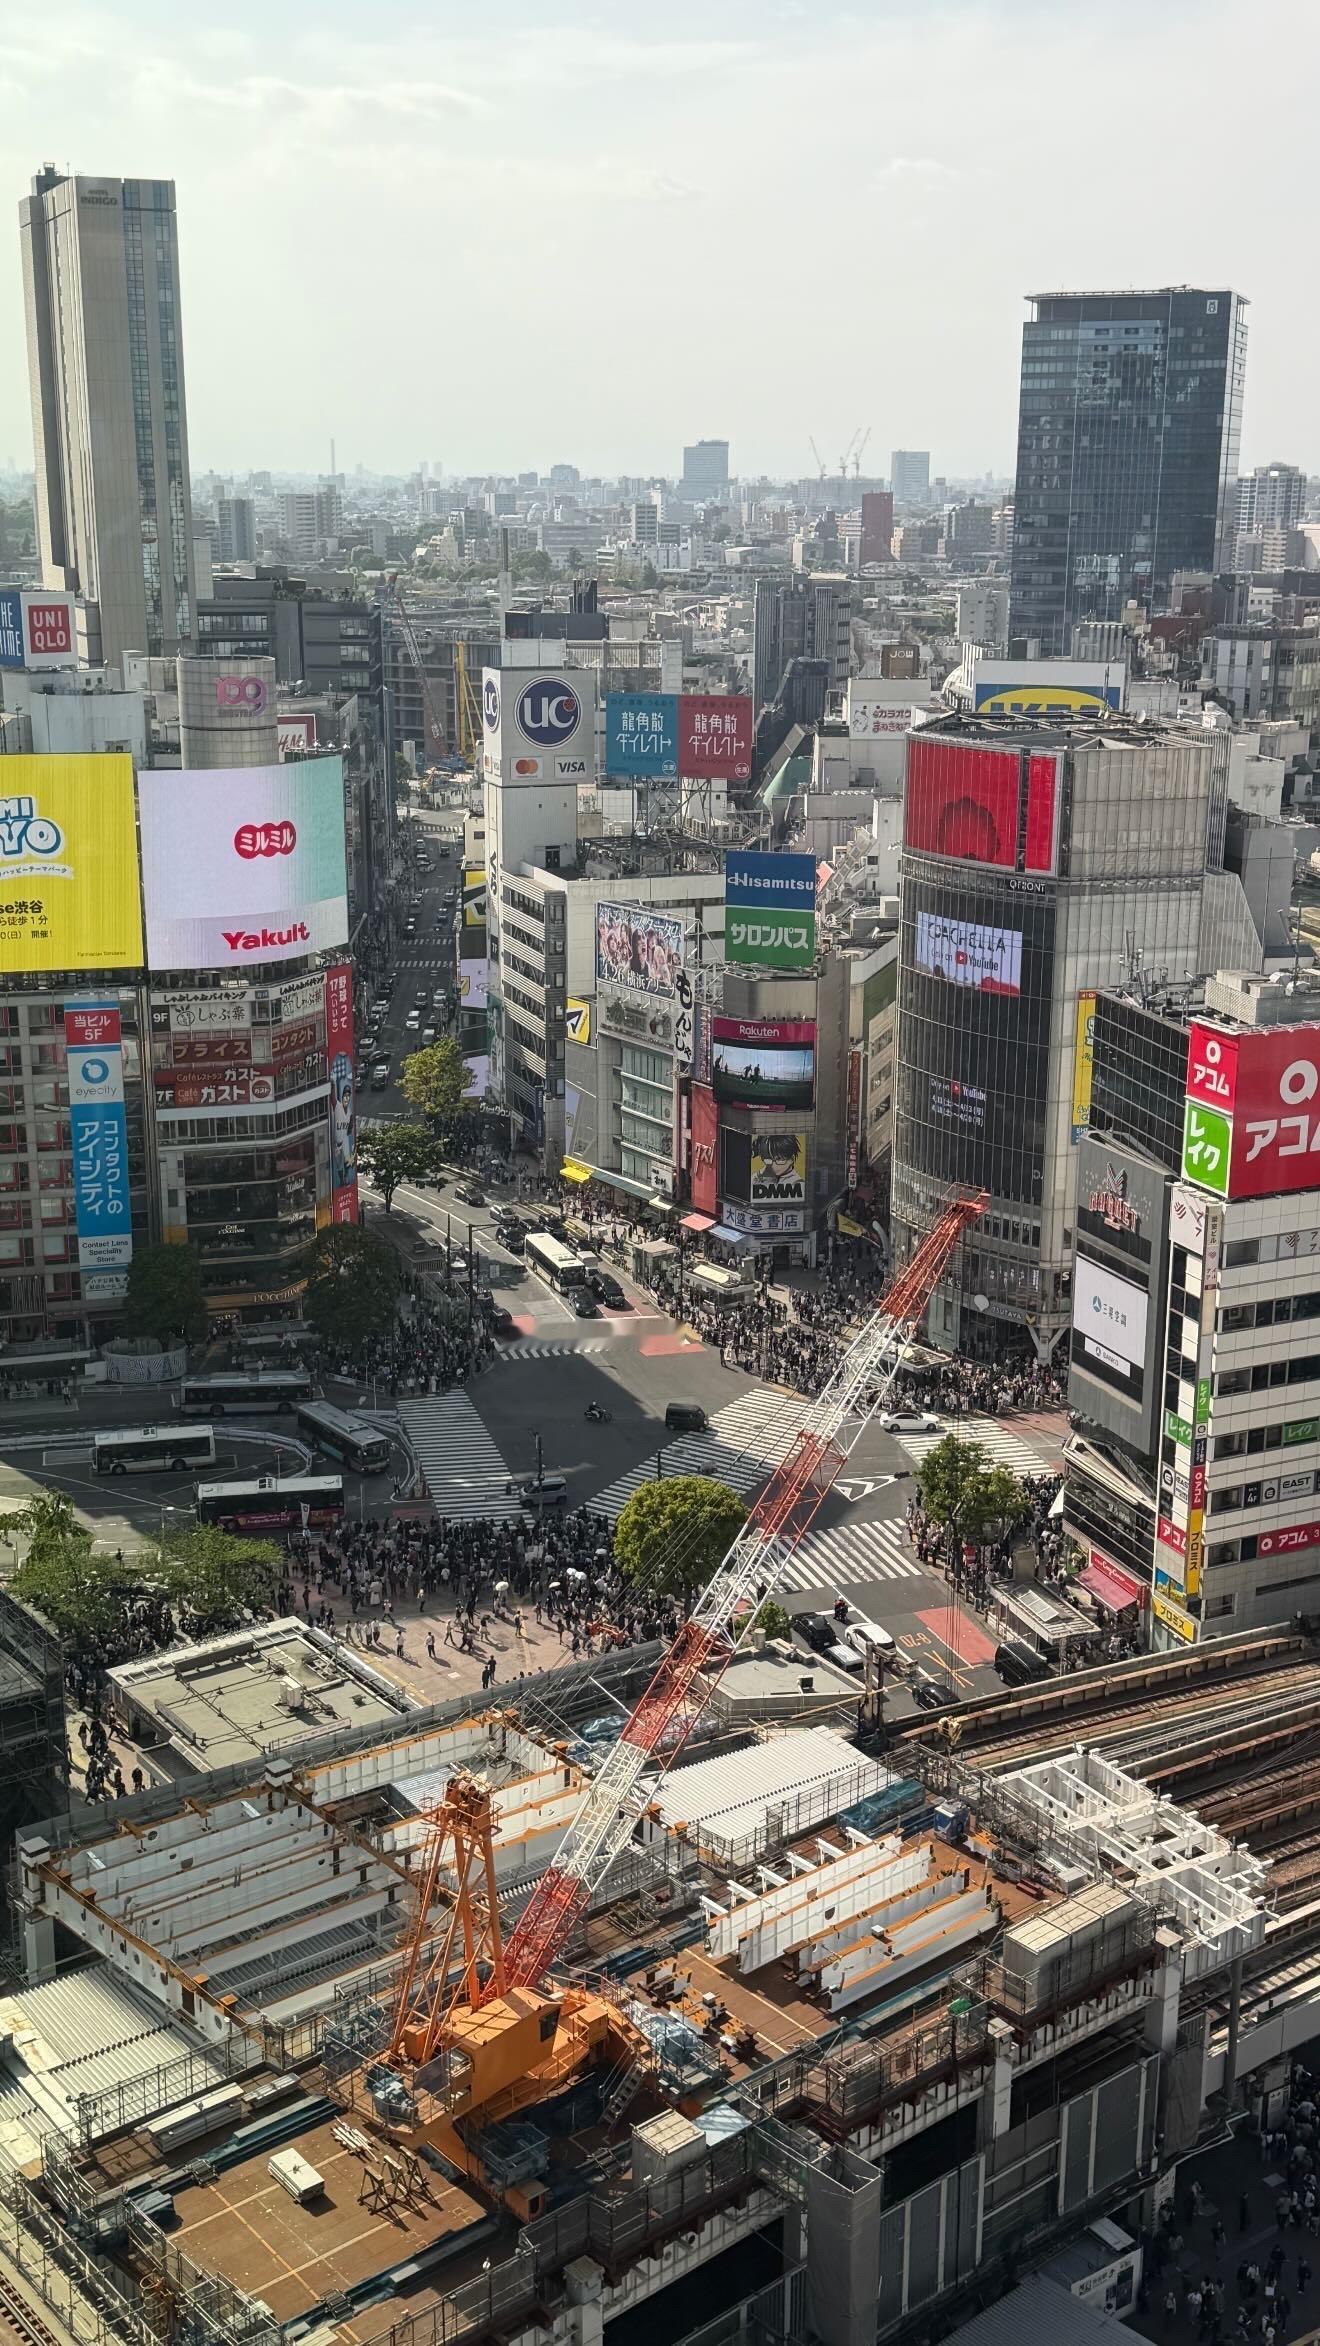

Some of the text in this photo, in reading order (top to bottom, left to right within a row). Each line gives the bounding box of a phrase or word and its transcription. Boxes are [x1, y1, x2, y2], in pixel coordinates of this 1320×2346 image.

[33, 611, 63, 628] UNI
[34, 630, 66, 650] QLO
[524, 697, 577, 728] UC
[622, 712, 664, 732] 龍角散
[694, 714, 738, 734] 龍角散
[616, 733, 672, 754] ダイレクト
[688, 736, 745, 756] ダイレクト
[556, 760, 586, 774] VISA
[240, 826, 294, 852] ミルミル
[221, 922, 310, 950] Yakult
[730, 924, 808, 950] サロンパス
[74, 1016, 111, 1027] 当ビル
[153, 1012, 168, 1023] 9F
[198, 1006, 246, 1022] しゃぶ葉
[676, 969, 694, 1060] もんじゃ
[84, 1029, 102, 1040] 5F
[740, 1024, 780, 1037] Rakuten
[224, 1067, 260, 1082] ガスト
[1193, 1062, 1230, 1098] アコム
[76, 1084, 116, 1098] eyecity
[156, 1090, 174, 1102] 7F
[200, 1085, 246, 1102] ガスト
[77, 1120, 104, 1216] アイシティ
[104, 1120, 124, 1214] コンタクトの
[752, 1183, 802, 1198] DMM
[726, 1208, 798, 1228] 大盛堂書店
[992, 1306, 1022, 1320] TSUTAYA
[1288, 1424, 1312, 1438] レイク
[1282, 1476, 1311, 1488] EAST
[1278, 1530, 1308, 1548] アコム
[1190, 1532, 1200, 1571] プロミス
[1160, 1604, 1186, 1630] プロミス
